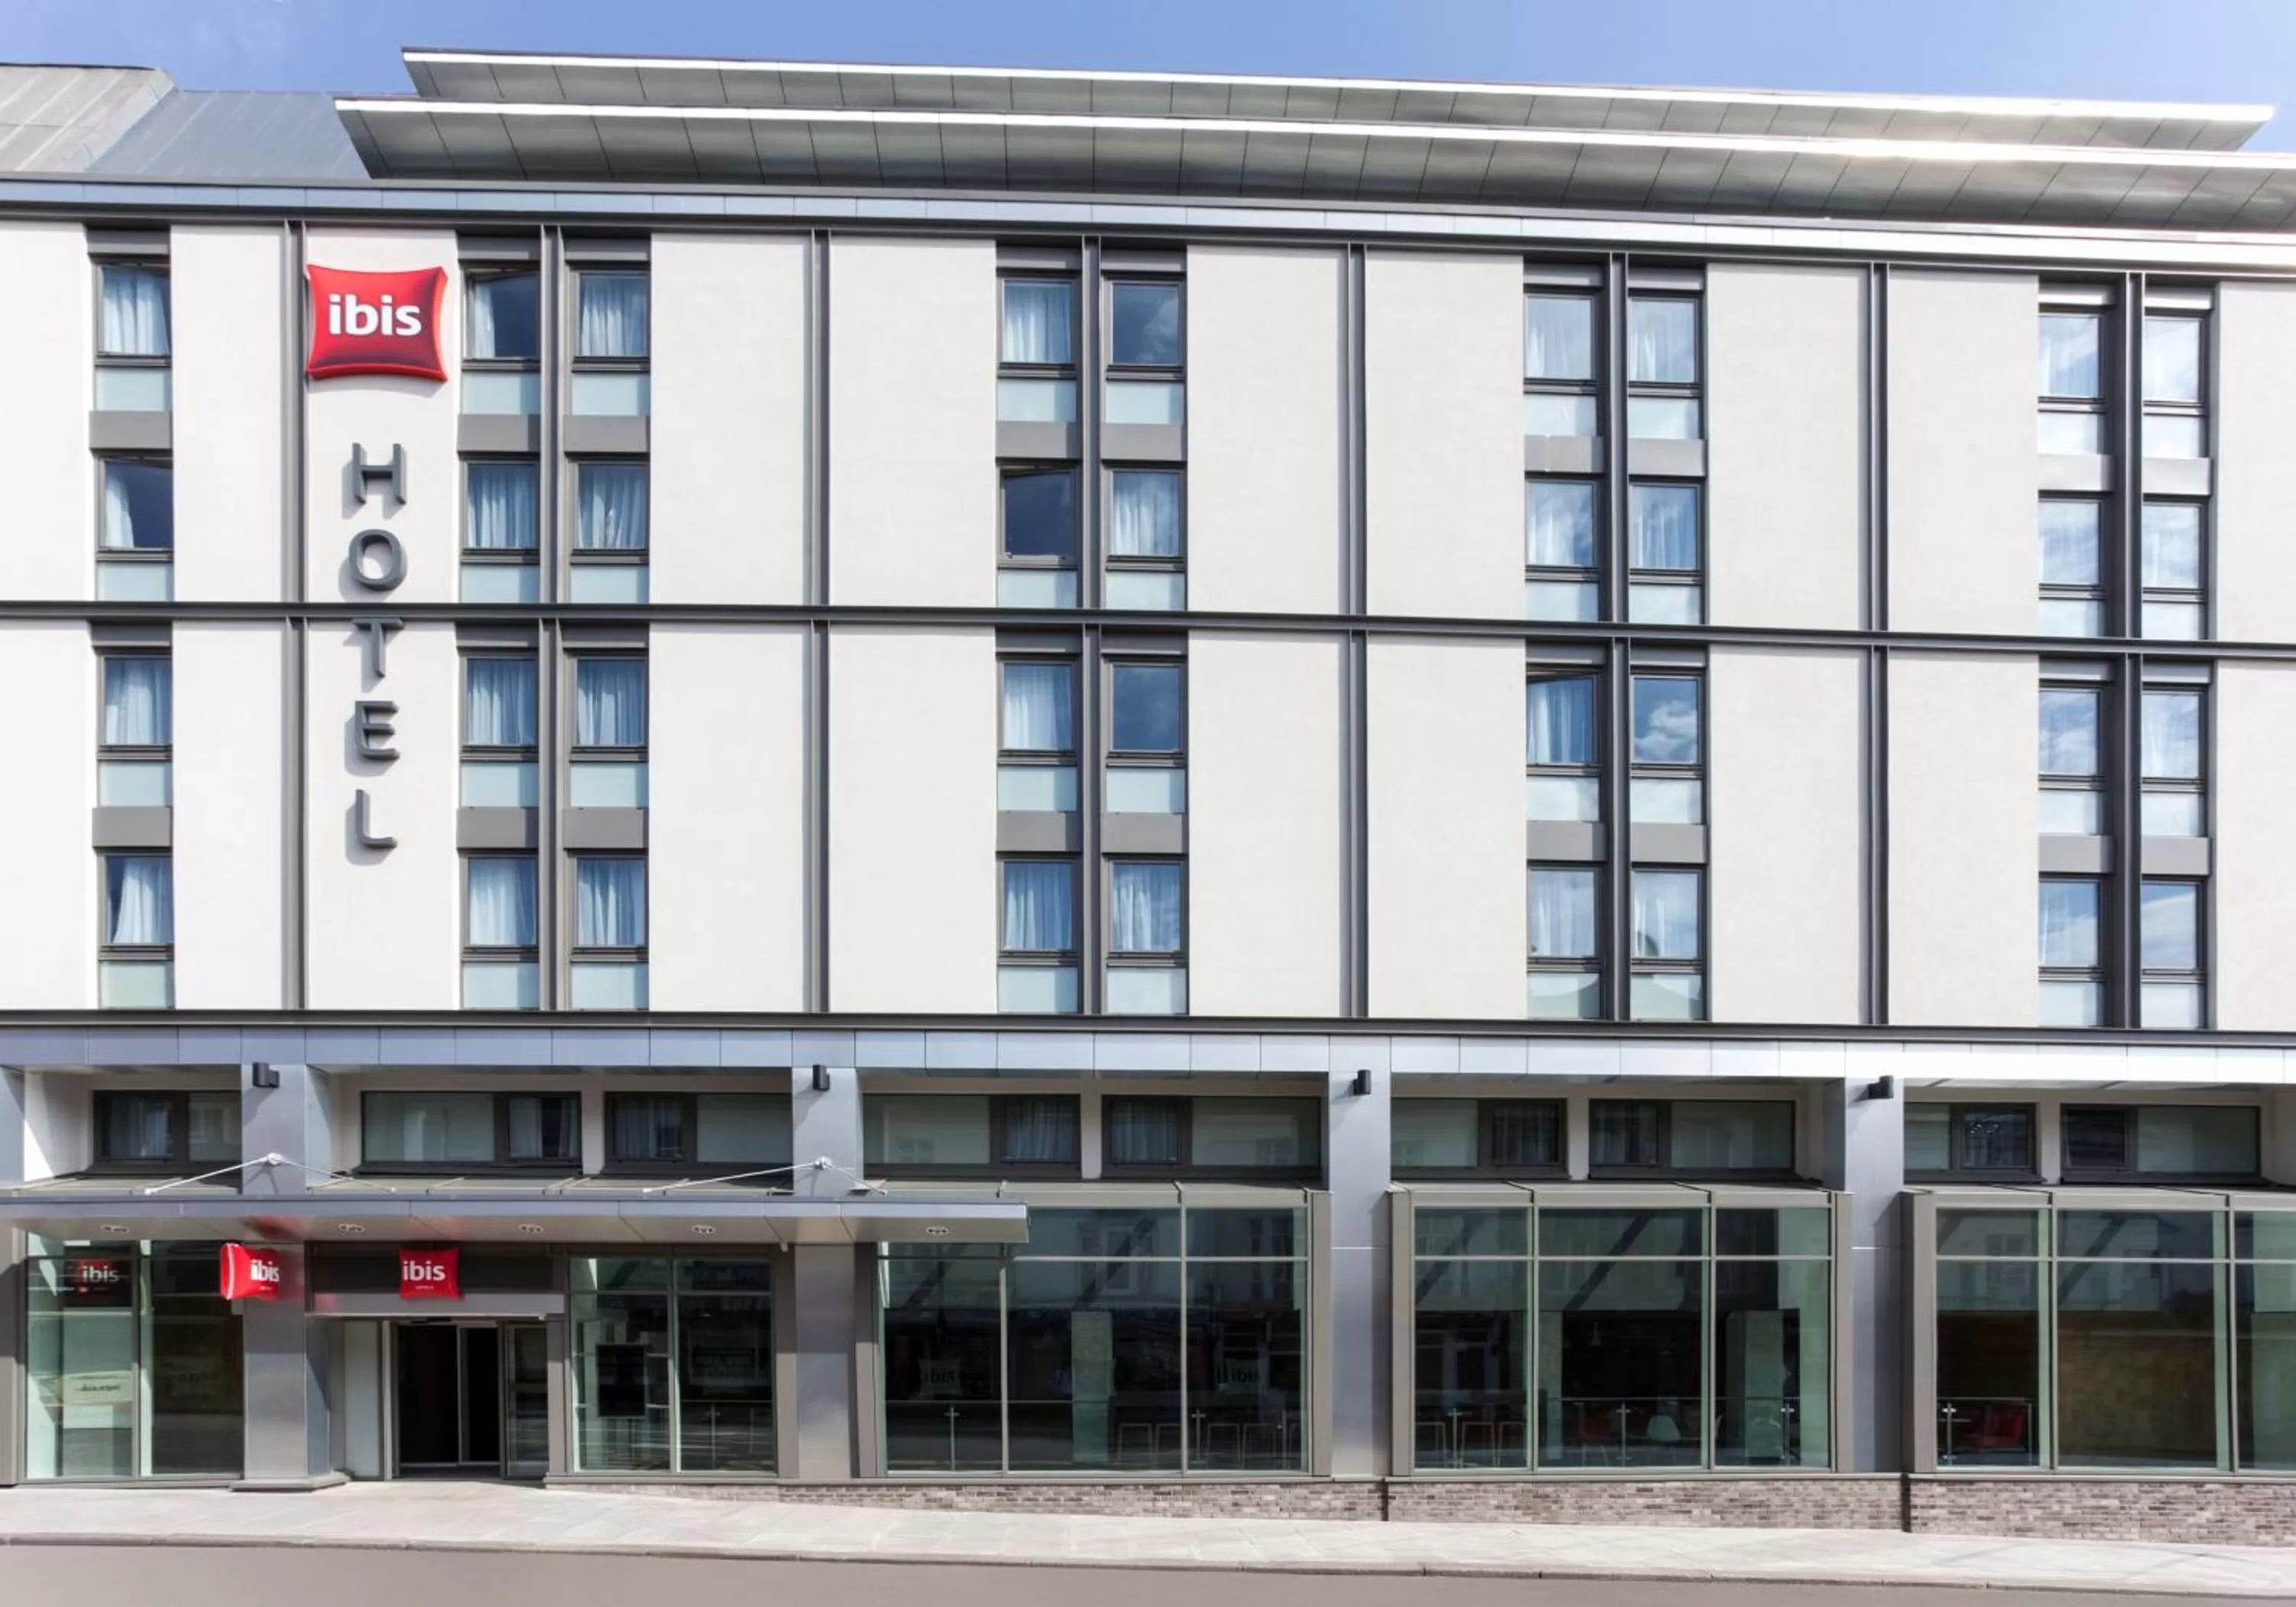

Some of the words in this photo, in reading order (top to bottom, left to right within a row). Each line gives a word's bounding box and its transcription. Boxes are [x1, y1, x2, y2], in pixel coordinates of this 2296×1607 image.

[328, 293, 422, 336] ibis
[349, 442, 407, 849] HOTEL
[82, 1265, 120, 1283] ibis
[250, 1259, 279, 1282] ibis
[403, 1260, 446, 1281] ibis
